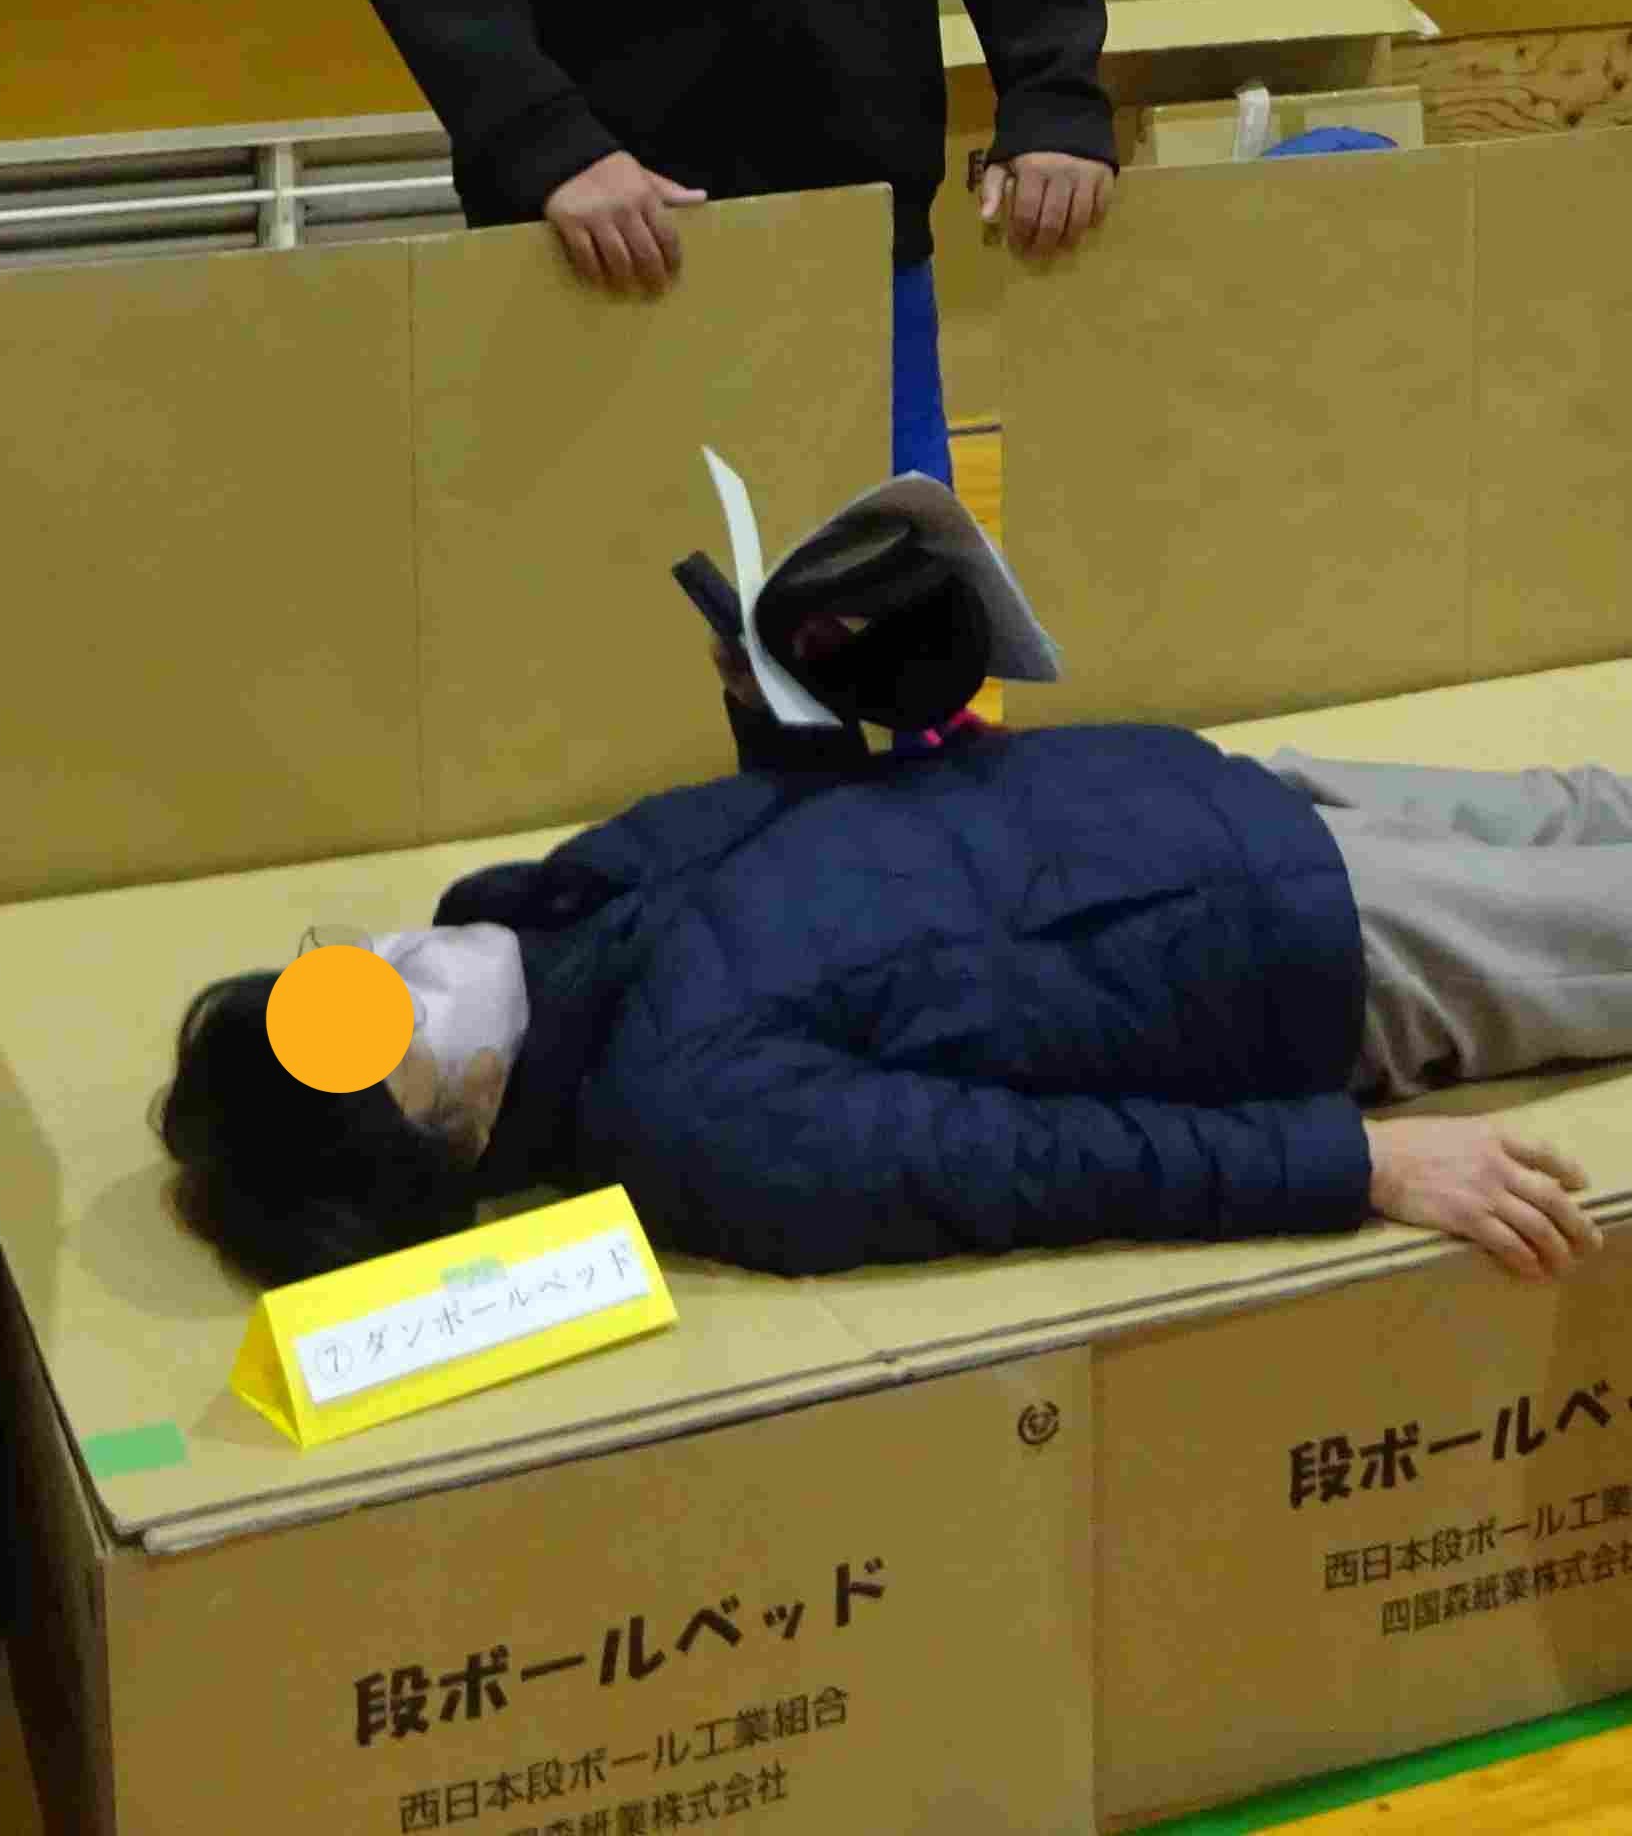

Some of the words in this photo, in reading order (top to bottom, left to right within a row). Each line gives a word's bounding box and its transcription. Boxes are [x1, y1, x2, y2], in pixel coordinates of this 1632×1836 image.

[353, 1556, 887, 1747] 段ボールベッド
[398, 1684, 850, 1835] 西日本段ボール工業組合
